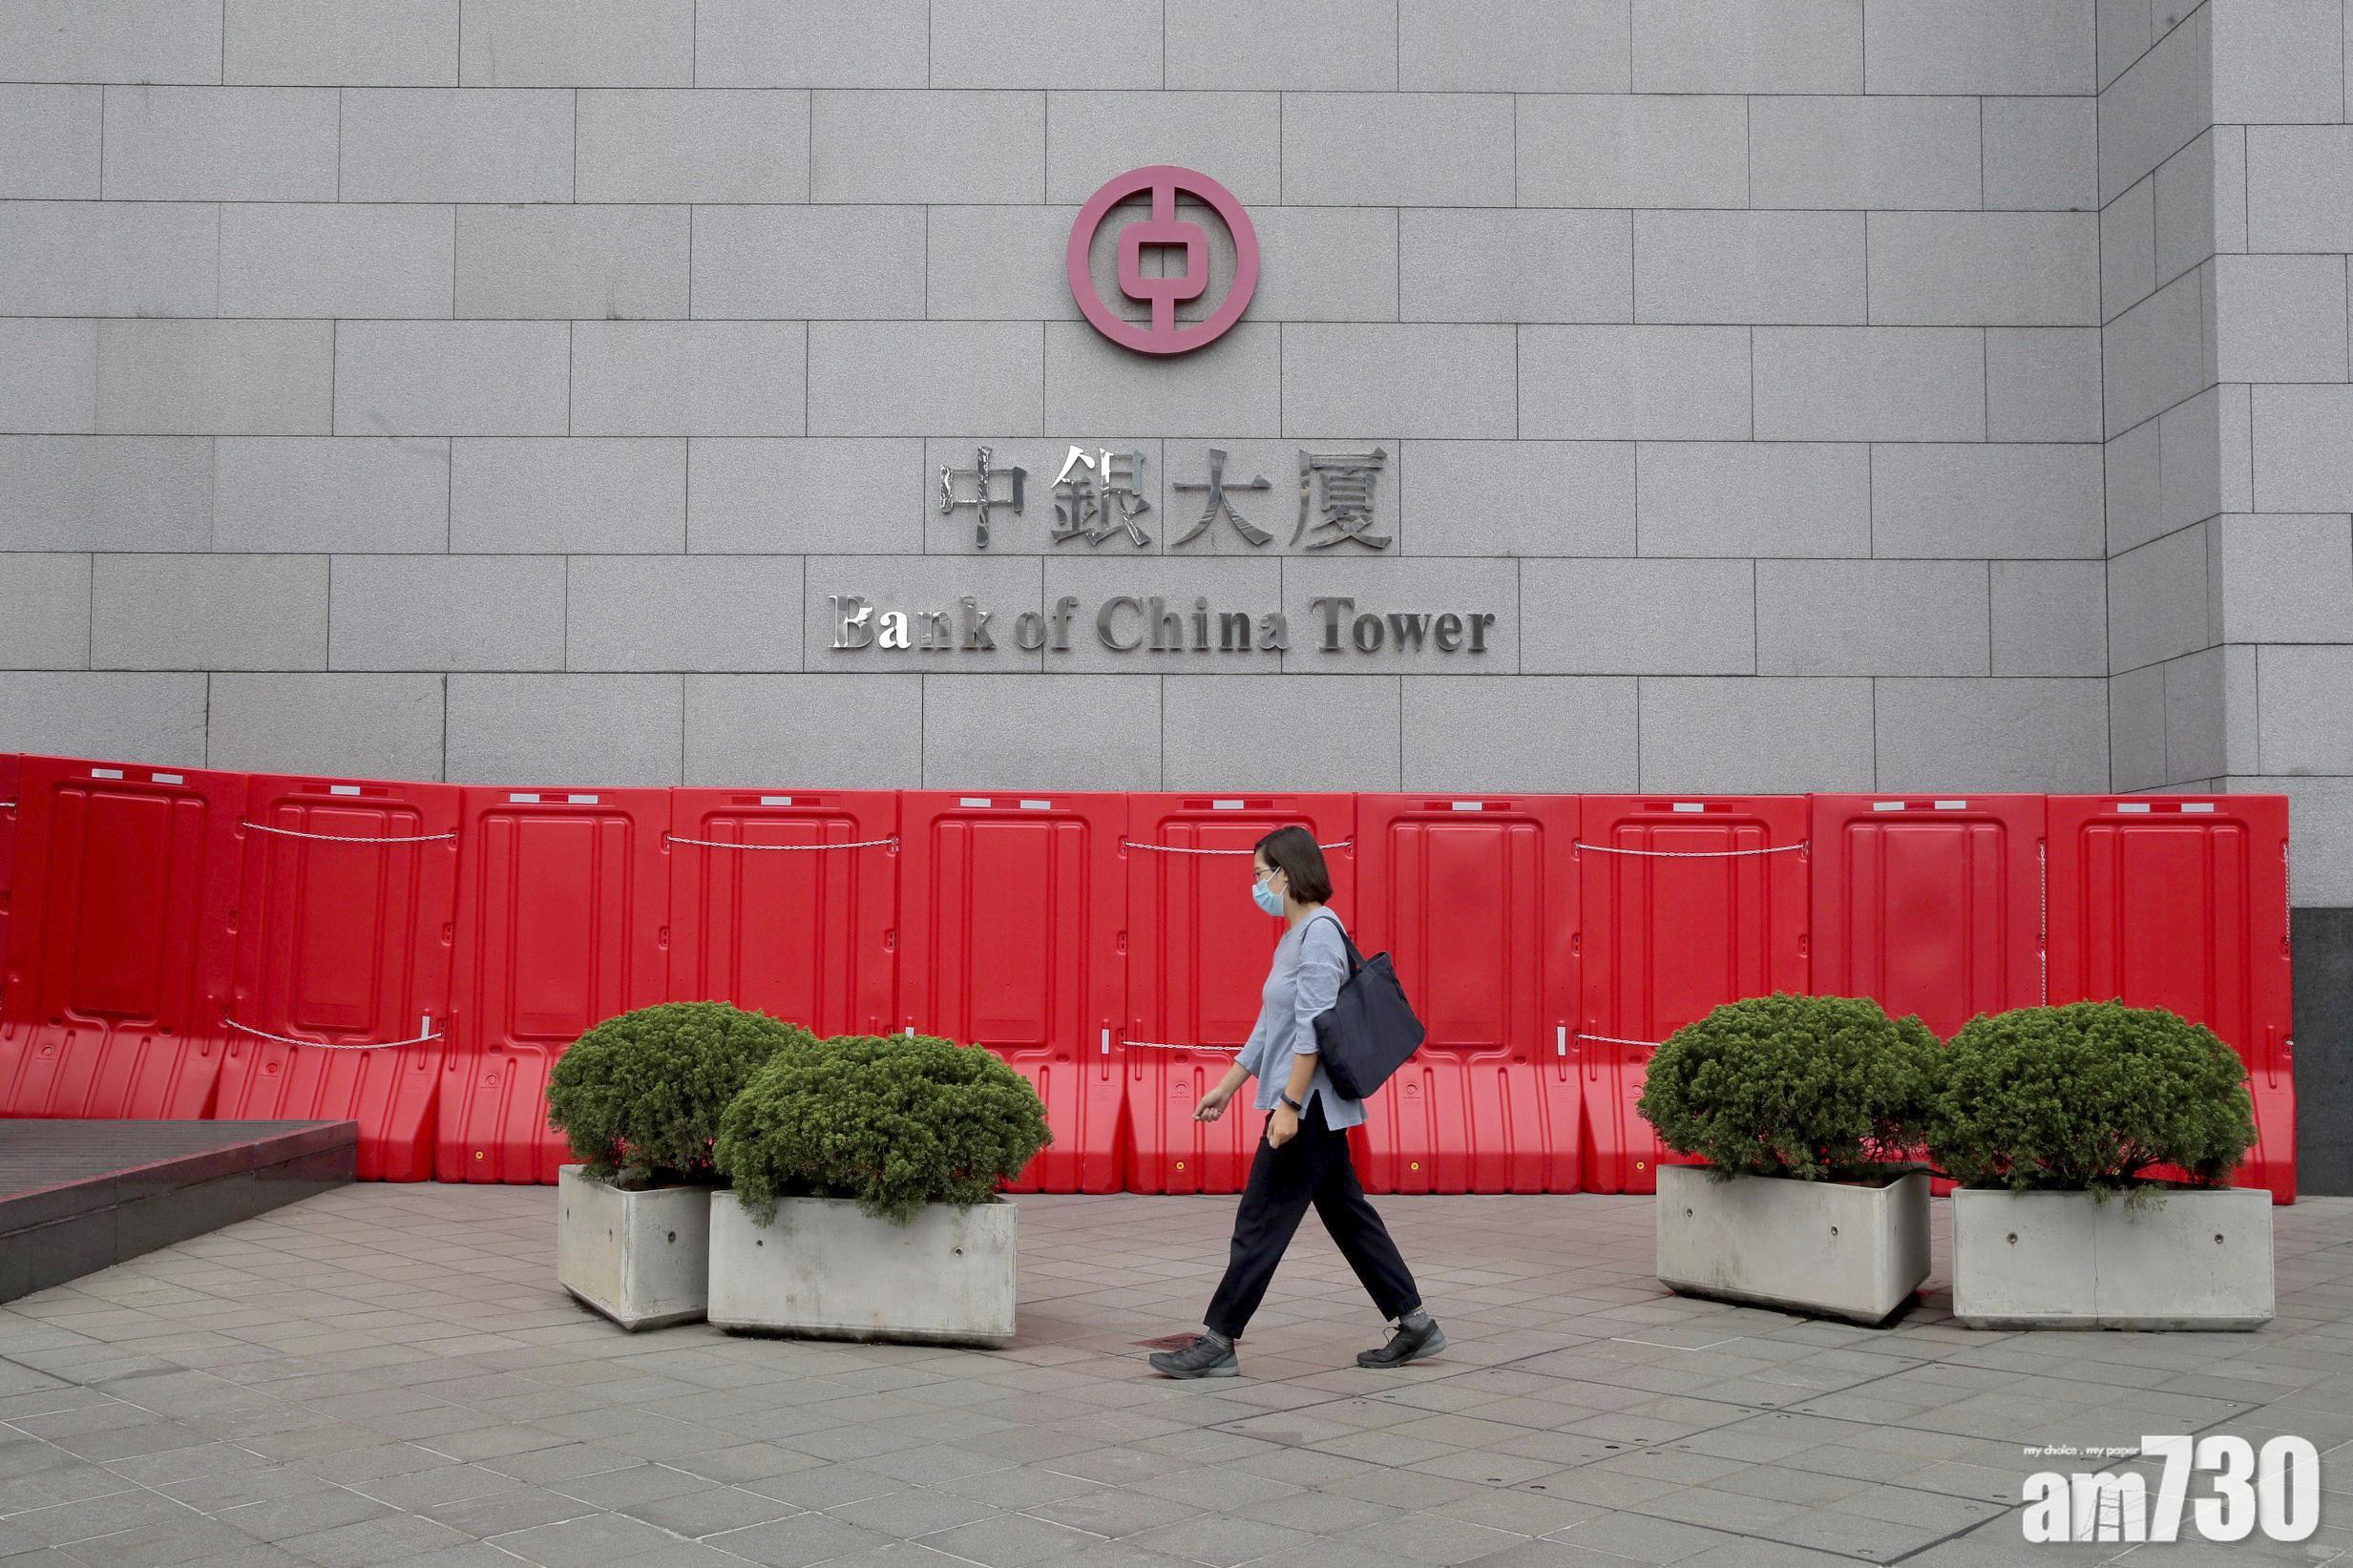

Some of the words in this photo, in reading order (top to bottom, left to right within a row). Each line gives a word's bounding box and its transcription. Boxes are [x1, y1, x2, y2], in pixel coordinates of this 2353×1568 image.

[939, 445, 1393, 551] 中銀大厦
[829, 595, 997, 651] Bank
[1014, 595, 1079, 651] of
[1096, 596, 1290, 652] China
[1311, 596, 1497, 653] Tower
